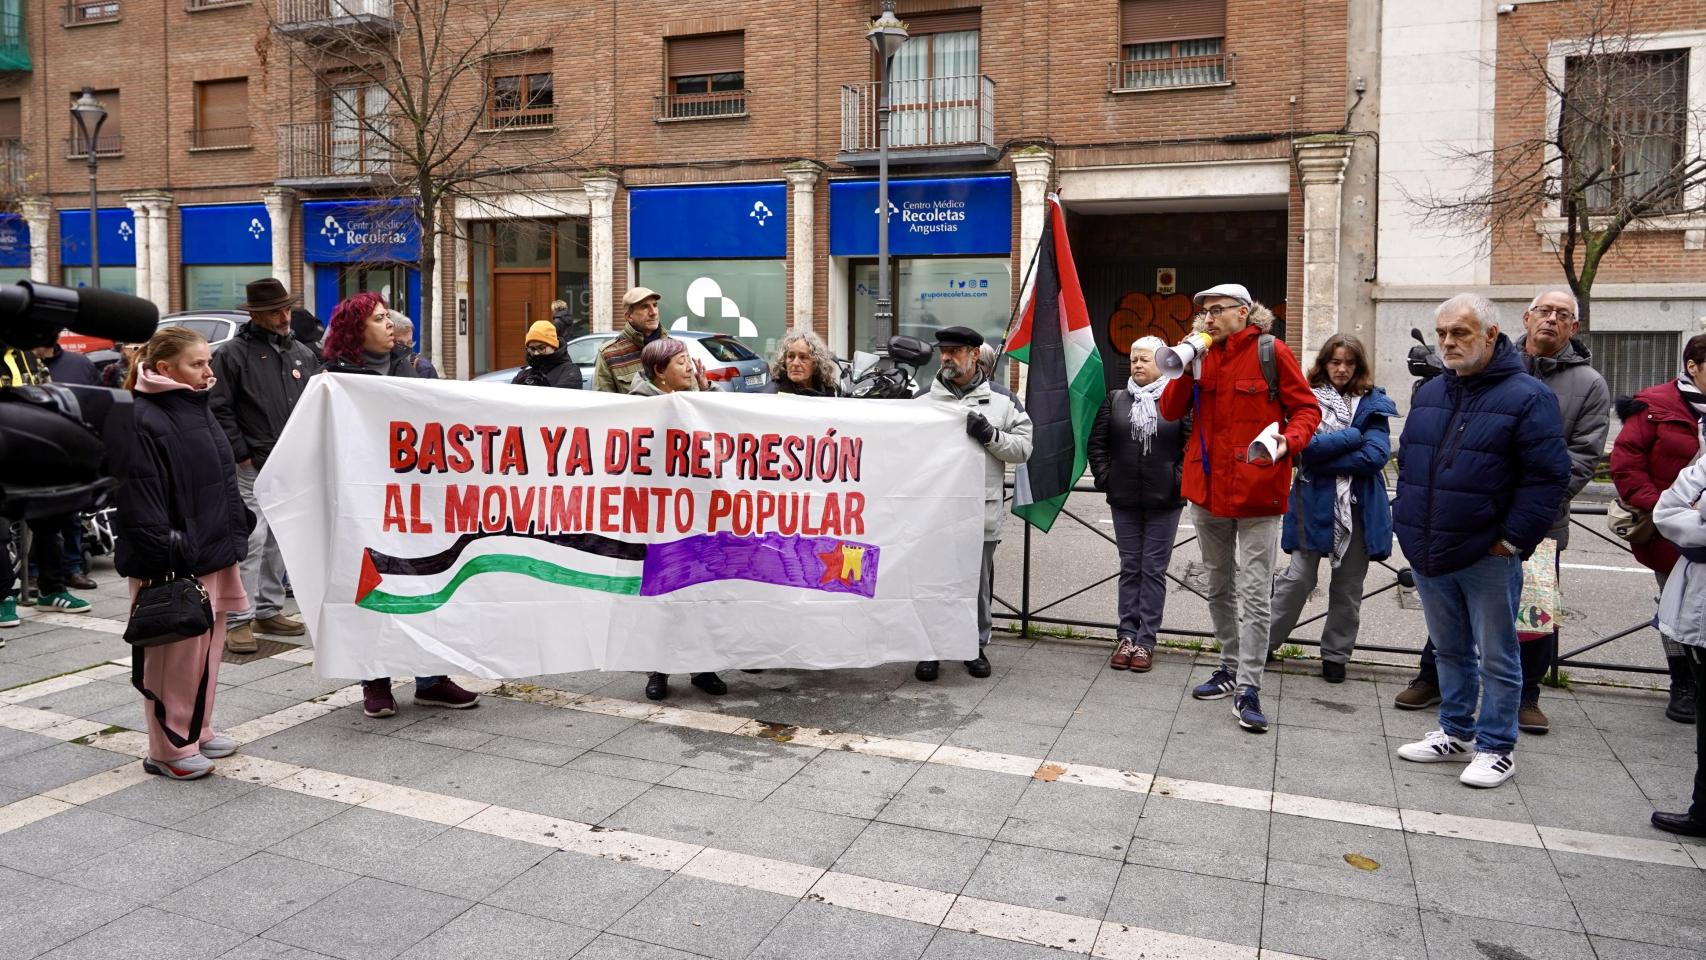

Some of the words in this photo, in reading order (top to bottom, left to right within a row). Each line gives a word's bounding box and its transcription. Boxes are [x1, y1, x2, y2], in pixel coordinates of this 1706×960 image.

[903, 201, 931, 209] Centro
[932, 200, 965, 209] Médico
[902, 209, 966, 222] Recoletas
[909, 222, 958, 234] Angustias
[920, 290, 988, 300] gruporecoletas.com
[388, 421, 528, 475] BASTA
[540, 426, 593, 477] YA
[604, 427, 654, 476] DE
[665, 428, 863, 482] REPRESIÓN
[382, 483, 433, 534] AL
[444, 484, 695, 536] MOVIMIENTO
[707, 489, 866, 536] POPULAR
